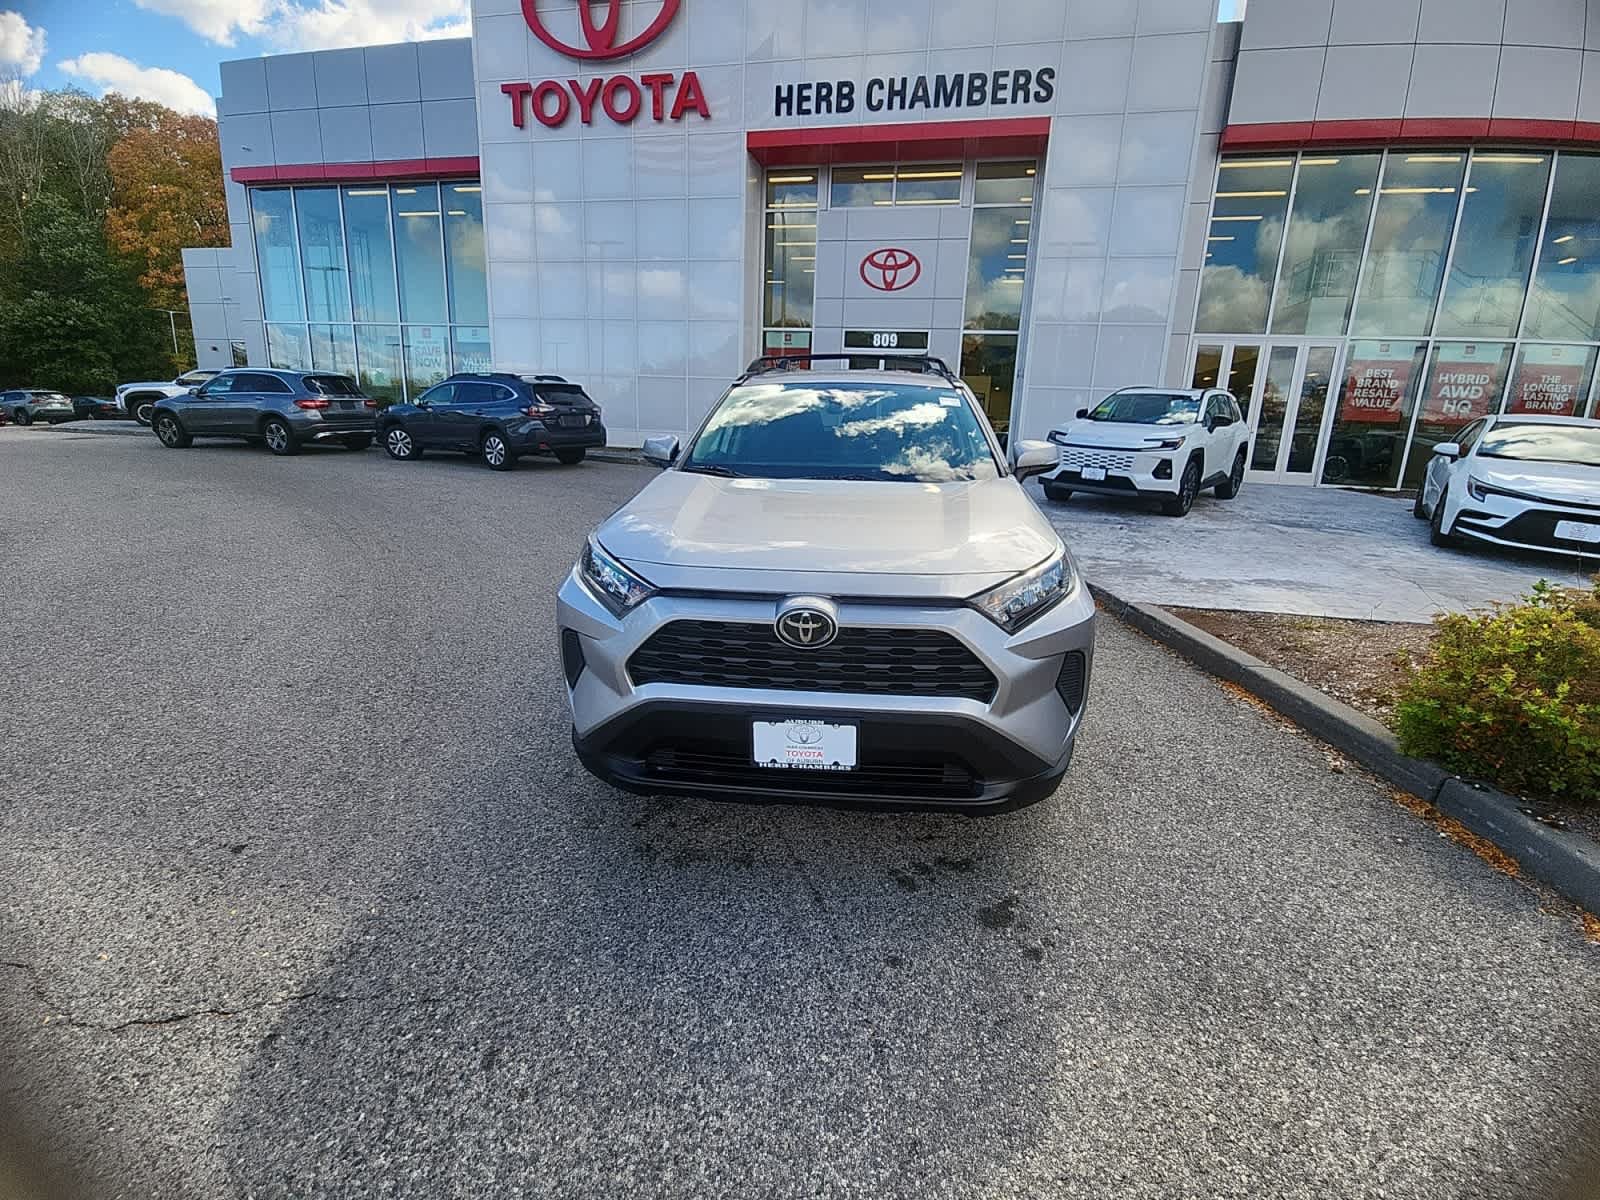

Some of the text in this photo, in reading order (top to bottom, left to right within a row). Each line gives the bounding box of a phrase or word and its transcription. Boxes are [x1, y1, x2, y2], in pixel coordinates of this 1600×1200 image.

[774, 67, 1055, 116] HERB CHAMBERS
[500, 71, 711, 128] TOYOTA
[873, 333, 898, 347] 809
[1366, 368, 1394, 378] BEST
[1438, 372, 1490, 385] HYBRID
[1356, 378, 1399, 389] BRAND
[1541, 375, 1562, 384] THE
[1353, 388, 1398, 399] RESALE
[1437, 384, 1484, 399] AWD
[1523, 383, 1574, 393] LONGEST
[1523, 392, 1569, 402] LASTING
[1355, 398, 1392, 409] VALUE
[1442, 399, 1473, 414] HQ
[1524, 400, 1564, 410] BRAND
[786, 750, 823, 758] TOYOTA
[791, 763, 852, 771] CHAMBERS
